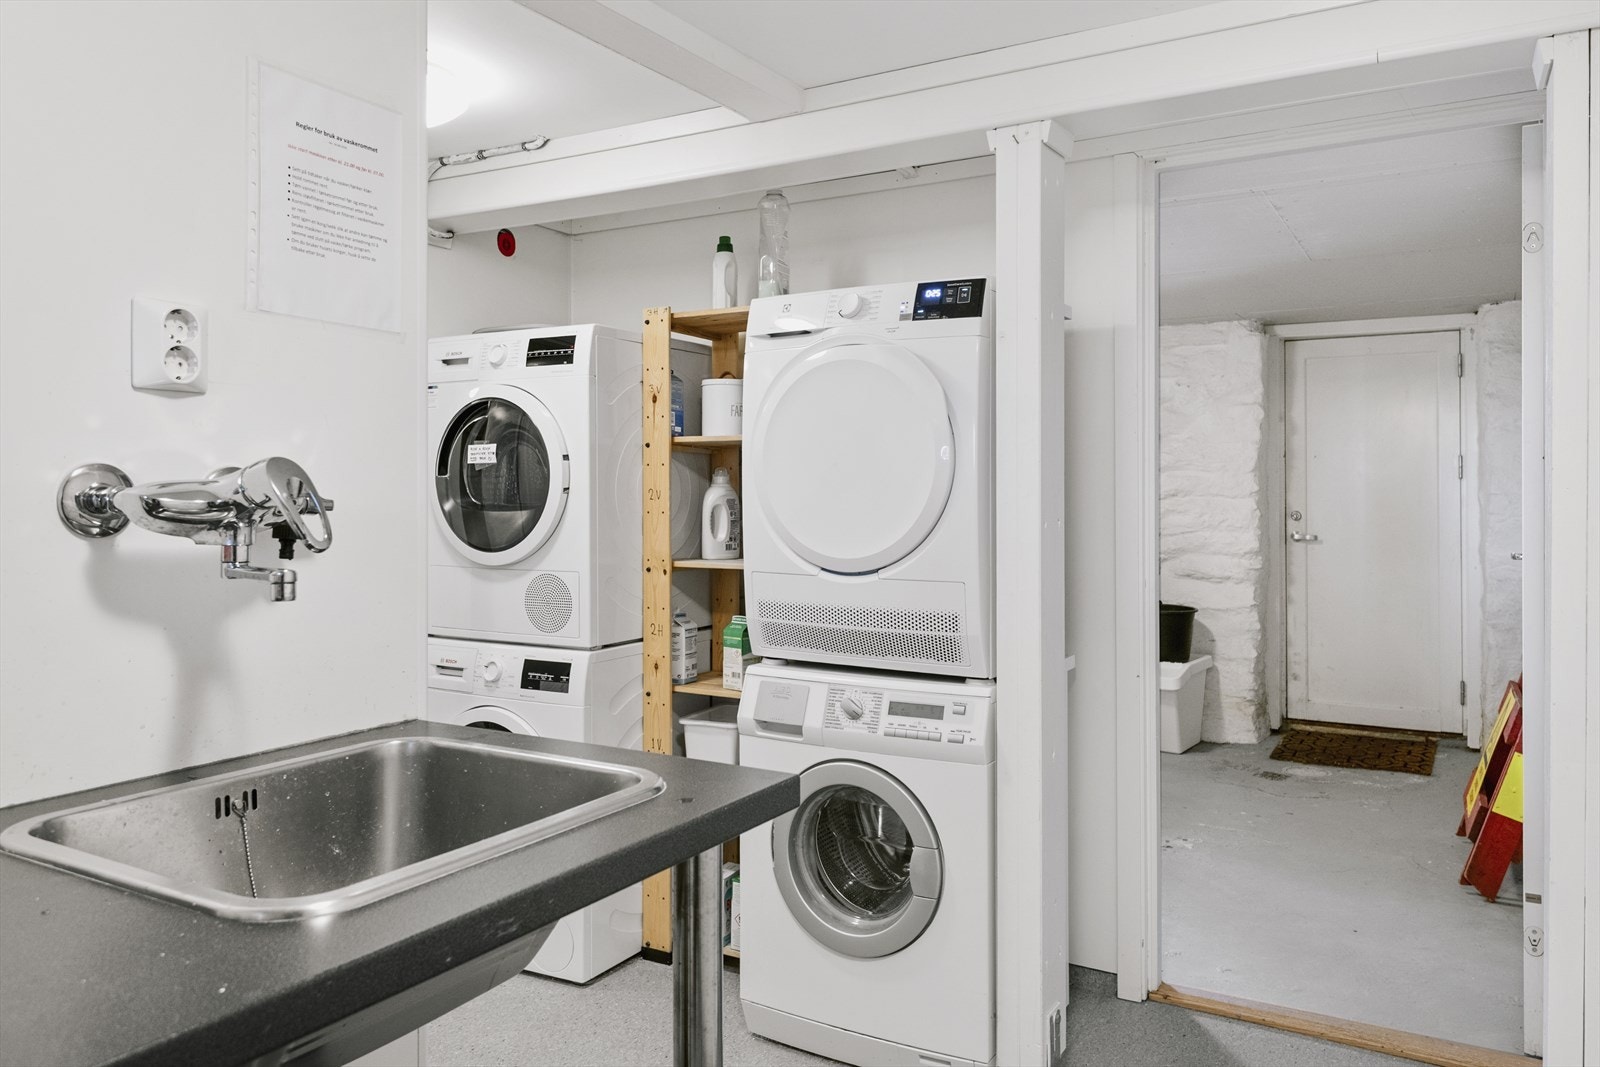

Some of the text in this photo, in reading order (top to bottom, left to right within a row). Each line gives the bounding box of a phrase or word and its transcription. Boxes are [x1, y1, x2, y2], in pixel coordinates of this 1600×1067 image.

[296, 122, 313, 130] Regler
[324, 130, 335, 139] bruk
[344, 139, 378, 153] vaskerommet
